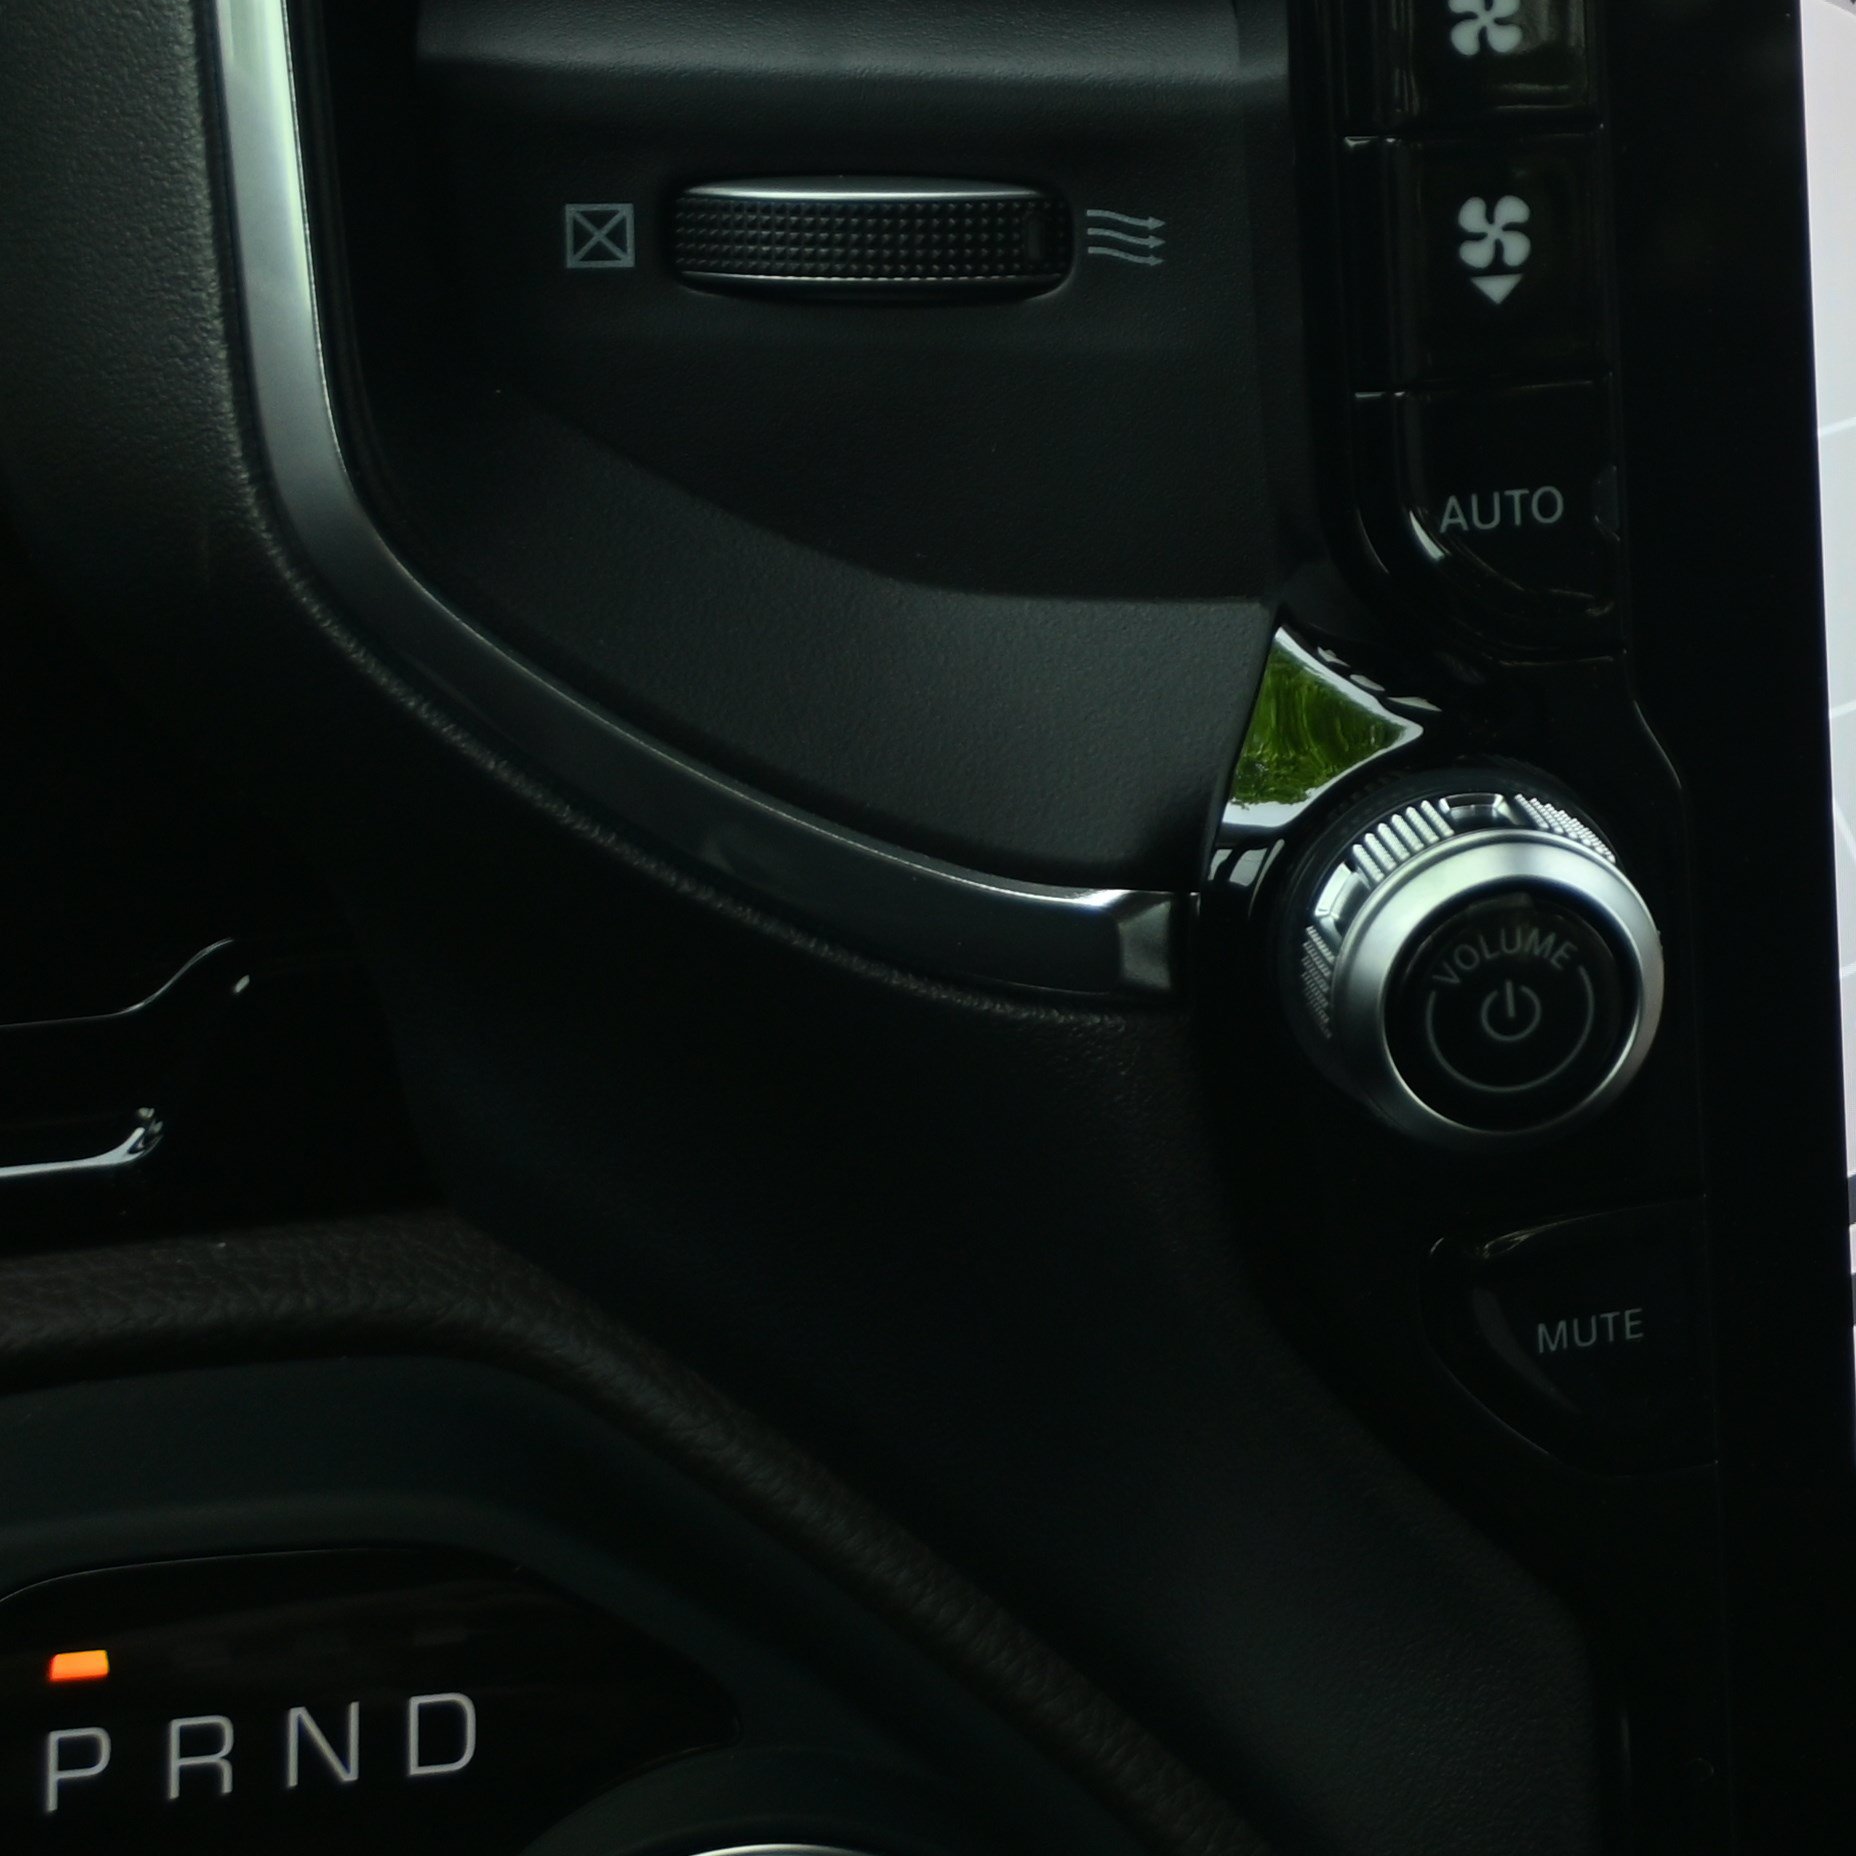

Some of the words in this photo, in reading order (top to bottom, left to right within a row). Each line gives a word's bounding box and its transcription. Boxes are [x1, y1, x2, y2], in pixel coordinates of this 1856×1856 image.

[1440, 487, 1564, 533] AUTO
[1432, 926, 1579, 988] VOLUME
[1537, 1308, 1645, 1354] MUTE
